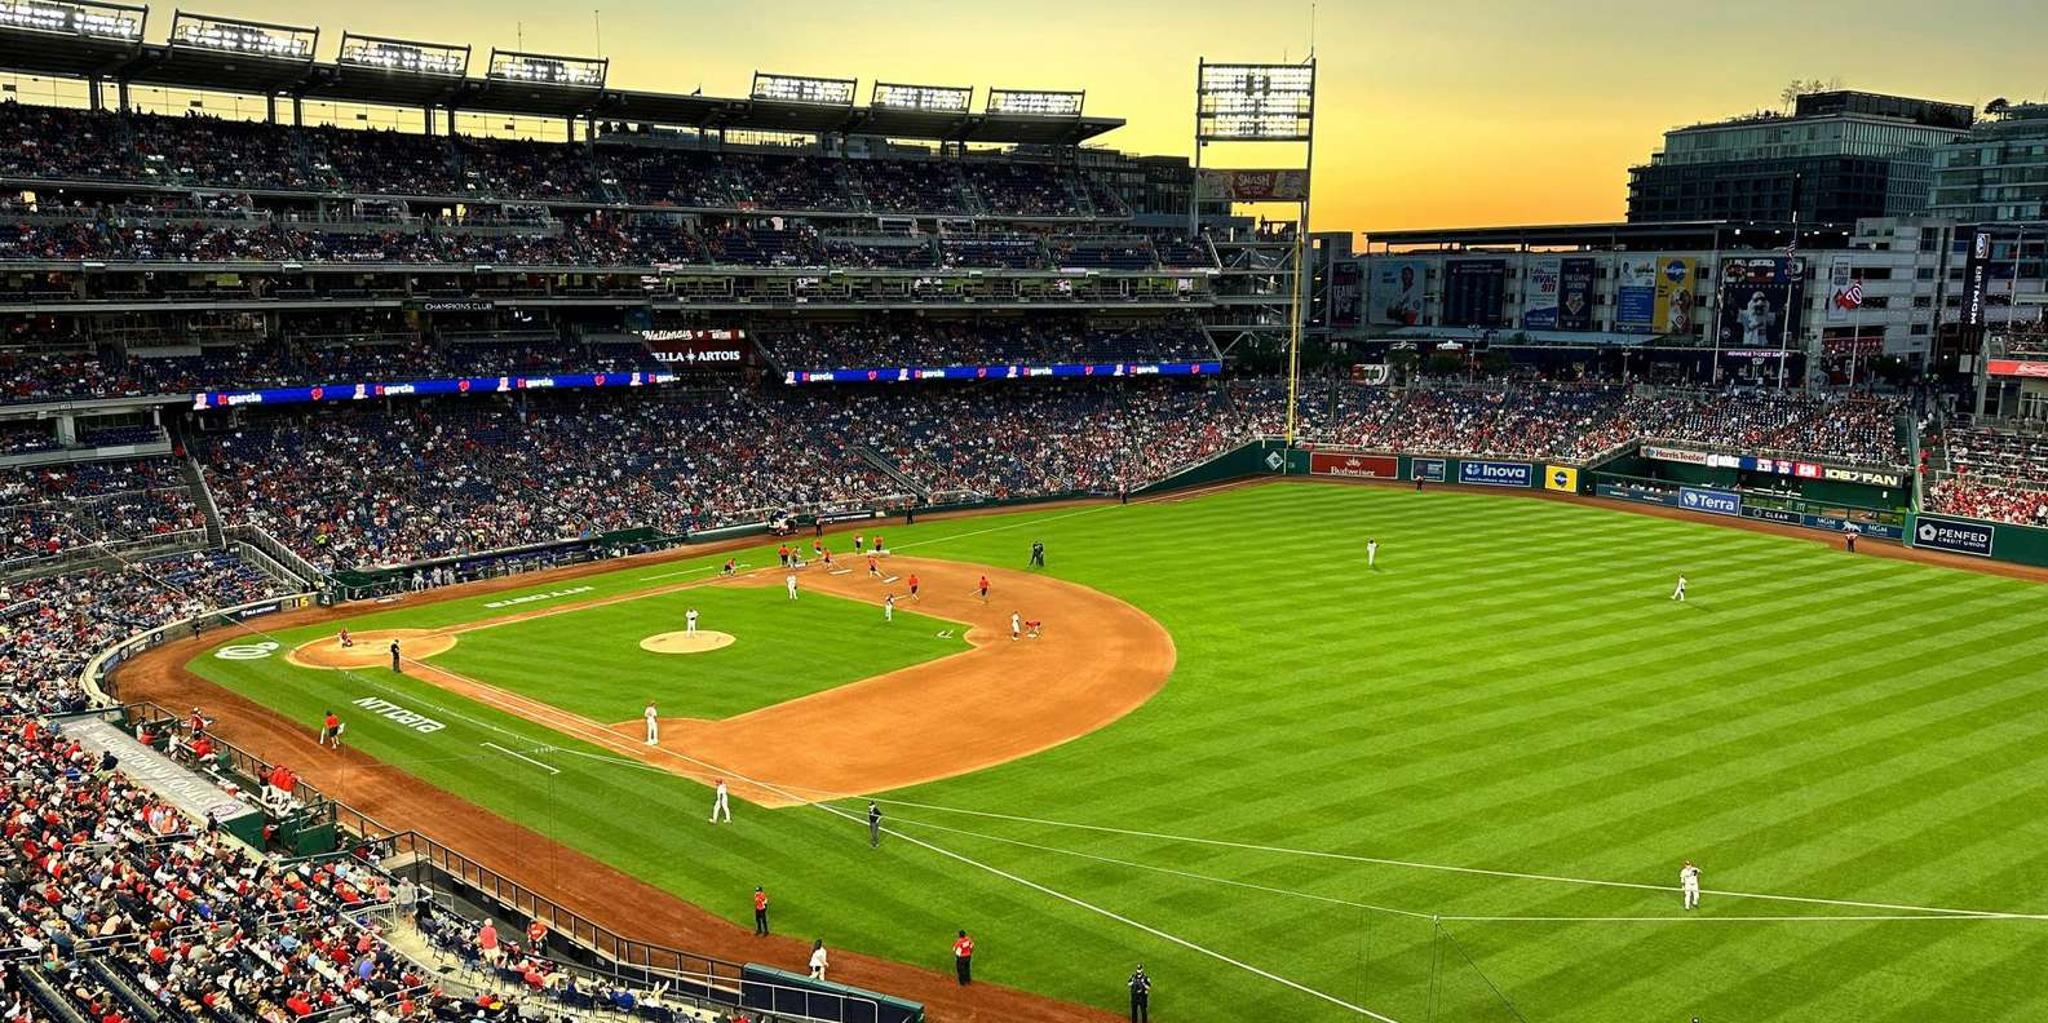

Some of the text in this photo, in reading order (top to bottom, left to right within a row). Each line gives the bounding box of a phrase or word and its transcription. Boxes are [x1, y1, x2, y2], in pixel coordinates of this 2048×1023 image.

[424, 302, 493, 311] CHAMPIONS CLUB
[698, 351, 740, 361] ARTOIS
[1483, 464, 1526, 478] Inova
[1862, 474, 1898, 486] FAN
[1698, 495, 1735, 511] Terra
[1765, 512, 1789, 521] CLEAR
[1938, 528, 1987, 543] PENFED
[1937, 537, 1986, 549] CREDIT UNION
